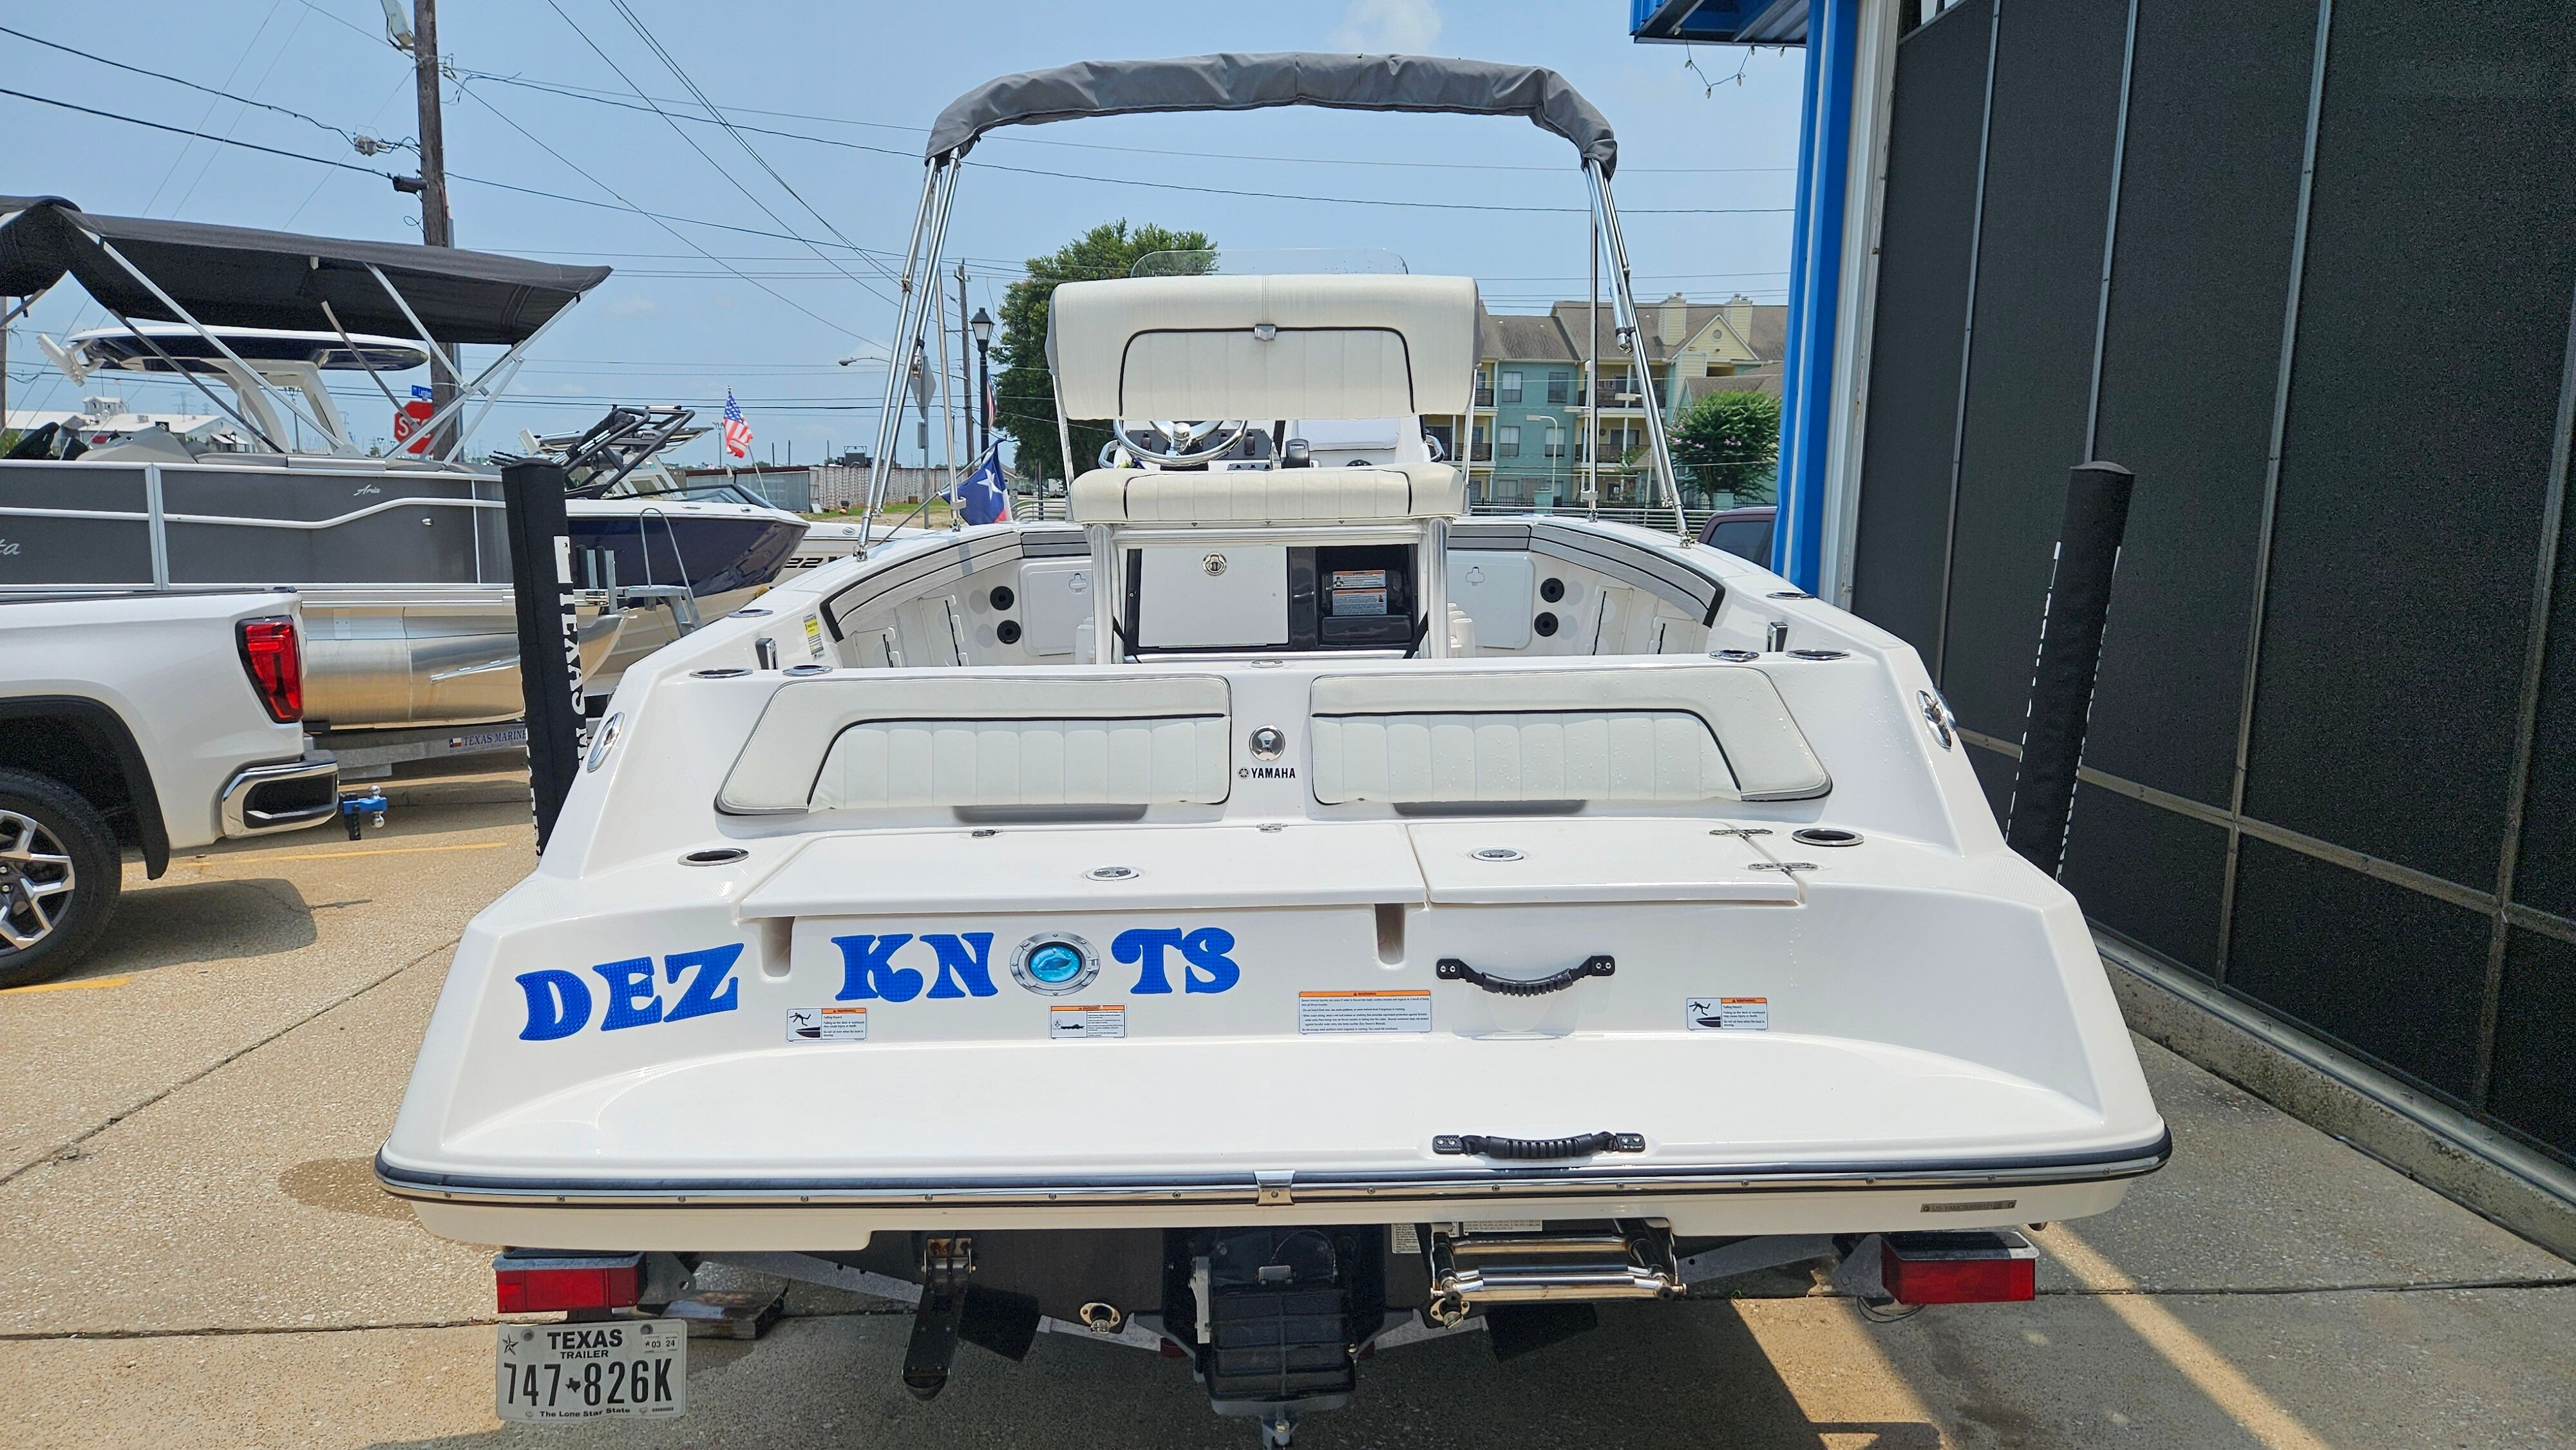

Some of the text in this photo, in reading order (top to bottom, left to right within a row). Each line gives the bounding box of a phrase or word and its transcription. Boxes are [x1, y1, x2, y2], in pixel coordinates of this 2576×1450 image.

[464, 730, 526, 746] TEXAS MARINE
[1251, 767, 1296, 778] YAMAHA
[515, 942, 744, 1040] DEZ
[547, 1328, 623, 1350] TEXAS
[560, 1350, 609, 1360] TRAILER
[583, 1409, 603, 1417] Star
